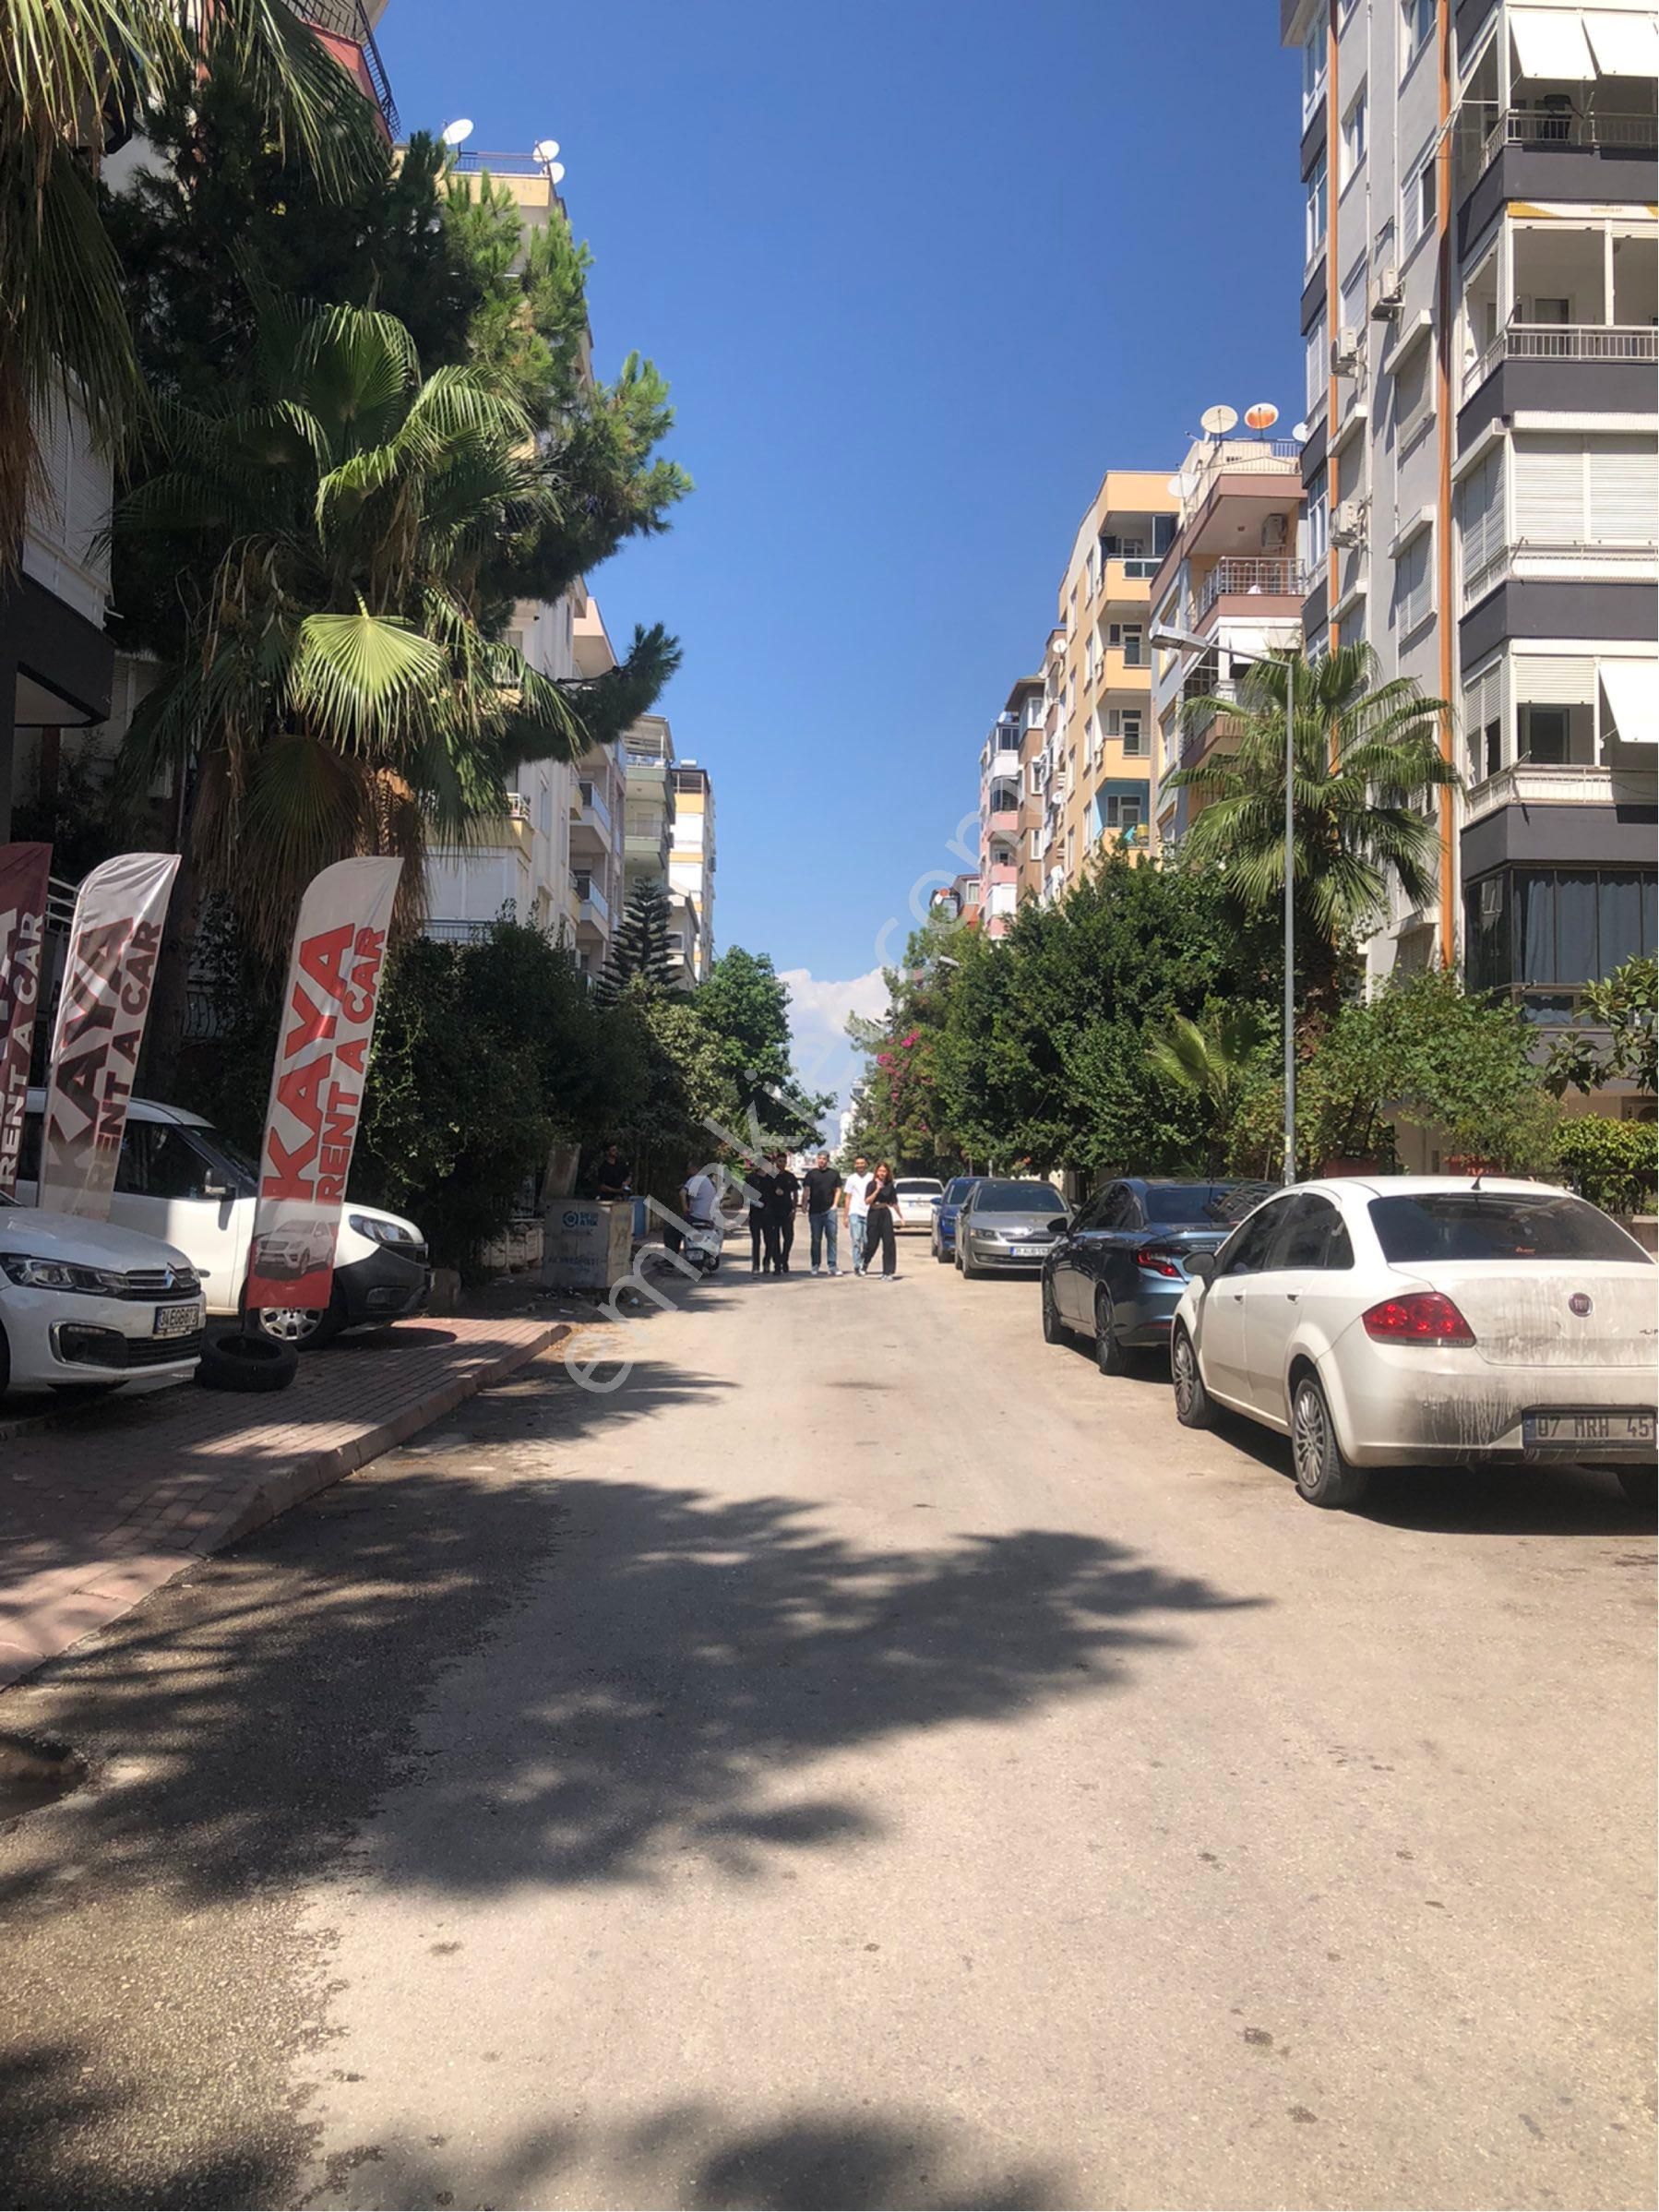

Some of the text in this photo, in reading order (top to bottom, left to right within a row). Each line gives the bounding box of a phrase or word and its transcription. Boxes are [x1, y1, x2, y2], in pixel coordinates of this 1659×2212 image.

[13, 912, 43, 1005] CAR
[13, 1021, 32, 1055] A
[45, 916, 134, 1188] KAYA
[89, 920, 161, 1190] RENT A CAR
[263, 923, 355, 1200] KAYA
[316, 927, 386, 1205] RENT A CAR
[0, 1064, 27, 1185] RENT
